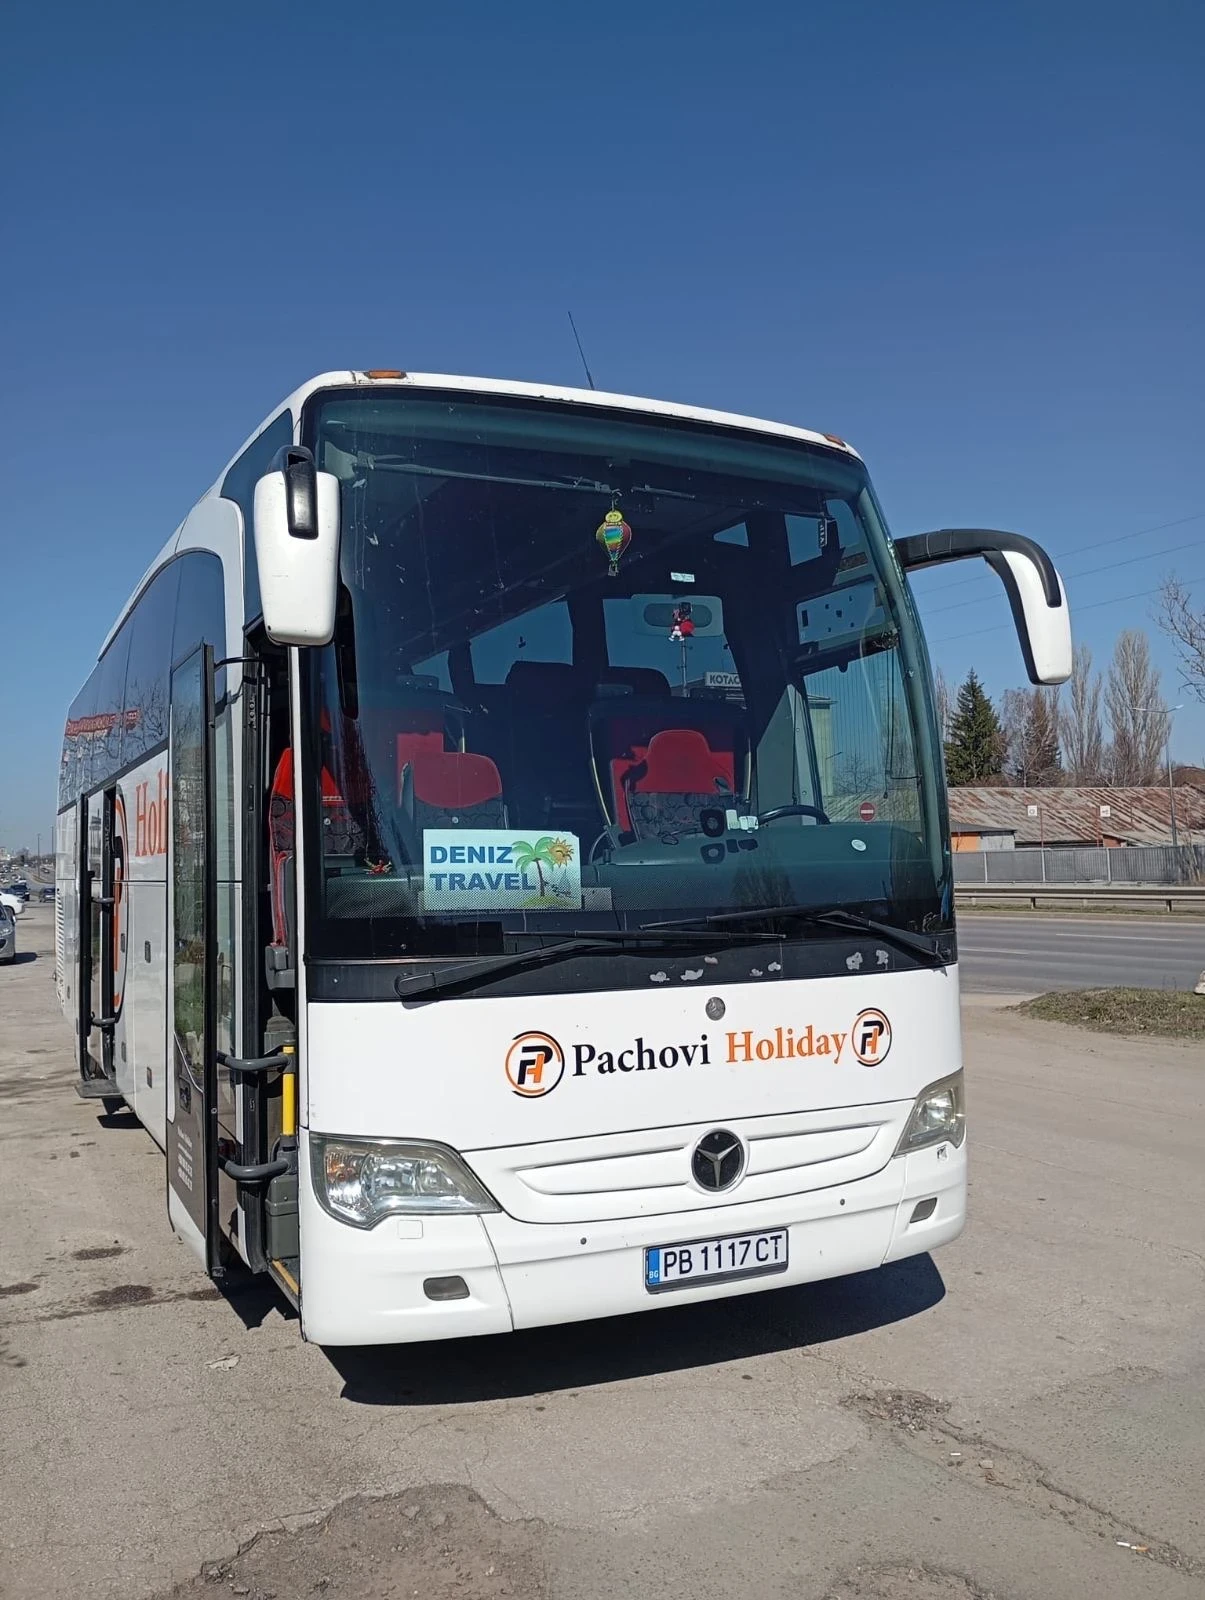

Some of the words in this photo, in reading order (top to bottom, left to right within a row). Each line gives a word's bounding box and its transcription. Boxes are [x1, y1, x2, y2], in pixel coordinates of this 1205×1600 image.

[430, 845, 514, 864] DENIZ
[430, 872, 537, 891] TRAVEL
[572, 1034, 711, 1077] Pachovi
[725, 1025, 848, 1065] Holiday
[648, 1270, 659, 1279] BG
